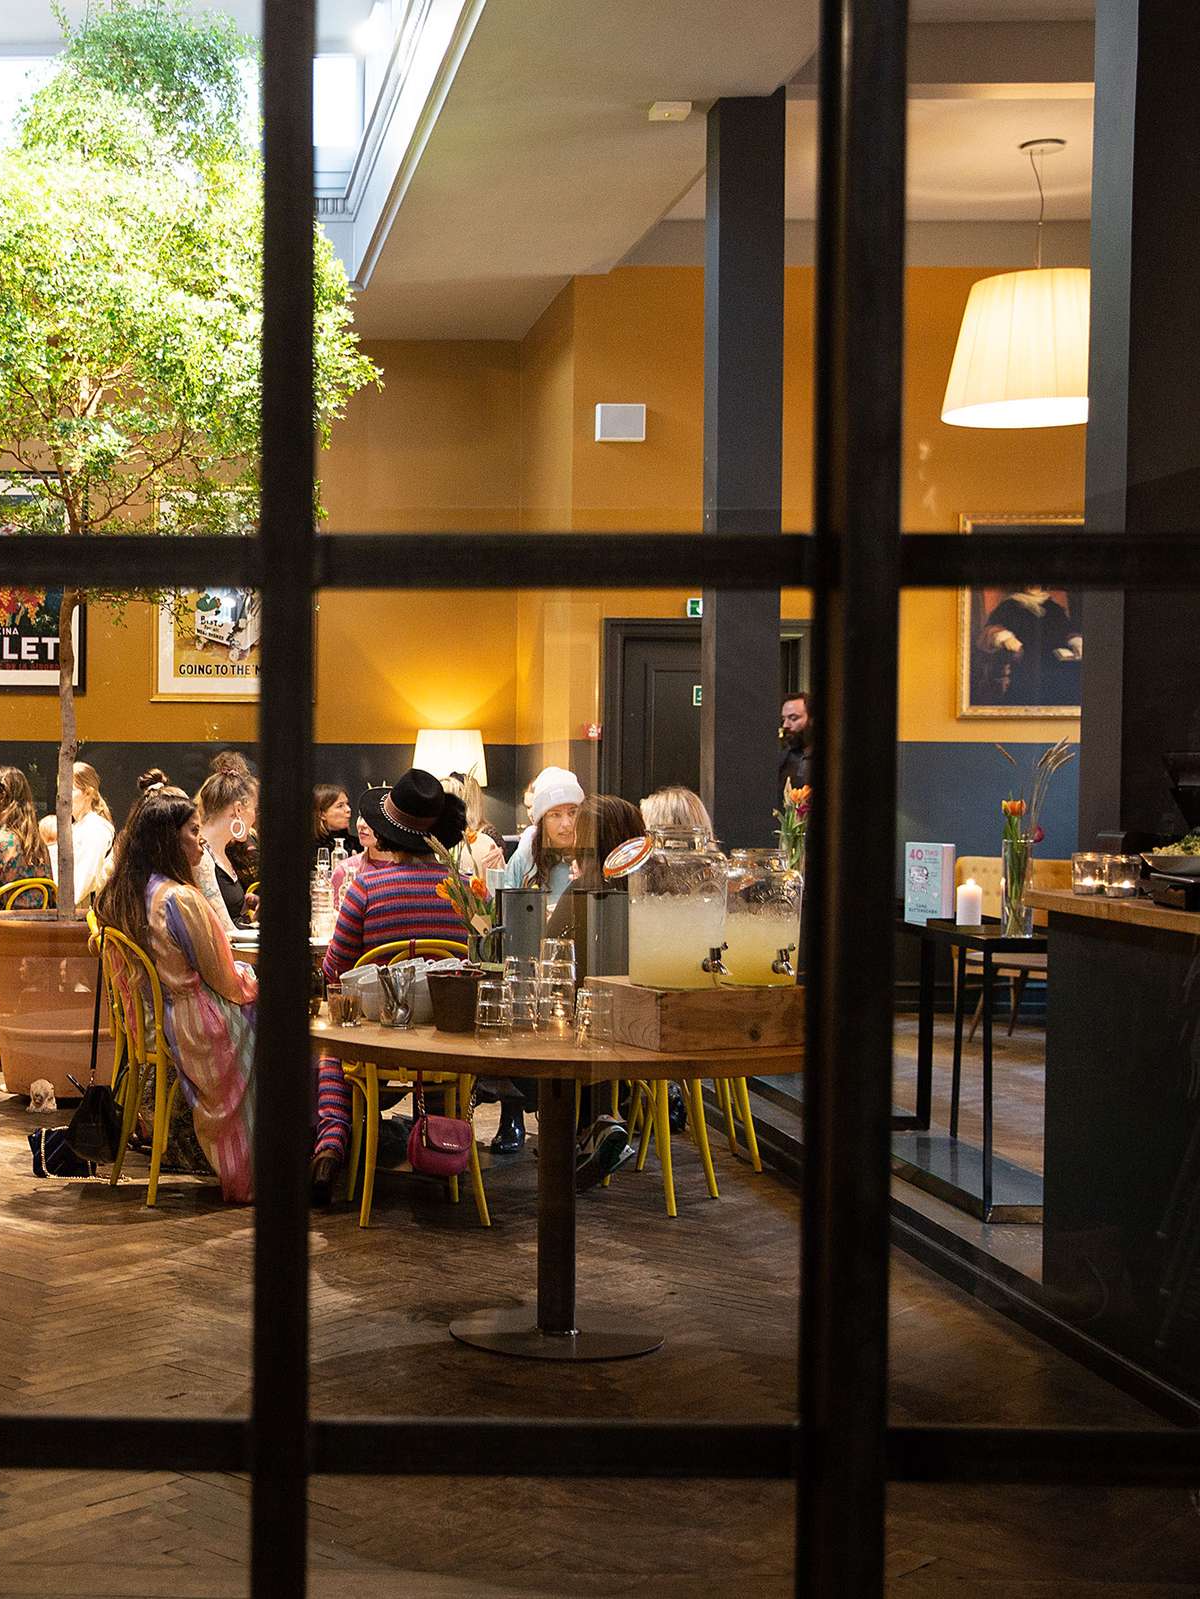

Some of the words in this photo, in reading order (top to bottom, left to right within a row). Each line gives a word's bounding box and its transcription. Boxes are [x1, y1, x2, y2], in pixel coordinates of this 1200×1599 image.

[179, 664, 212, 675] GOING
[215, 664, 228, 675] TO
[230, 664, 251, 675] THE
[910, 849, 924, 860] 40
